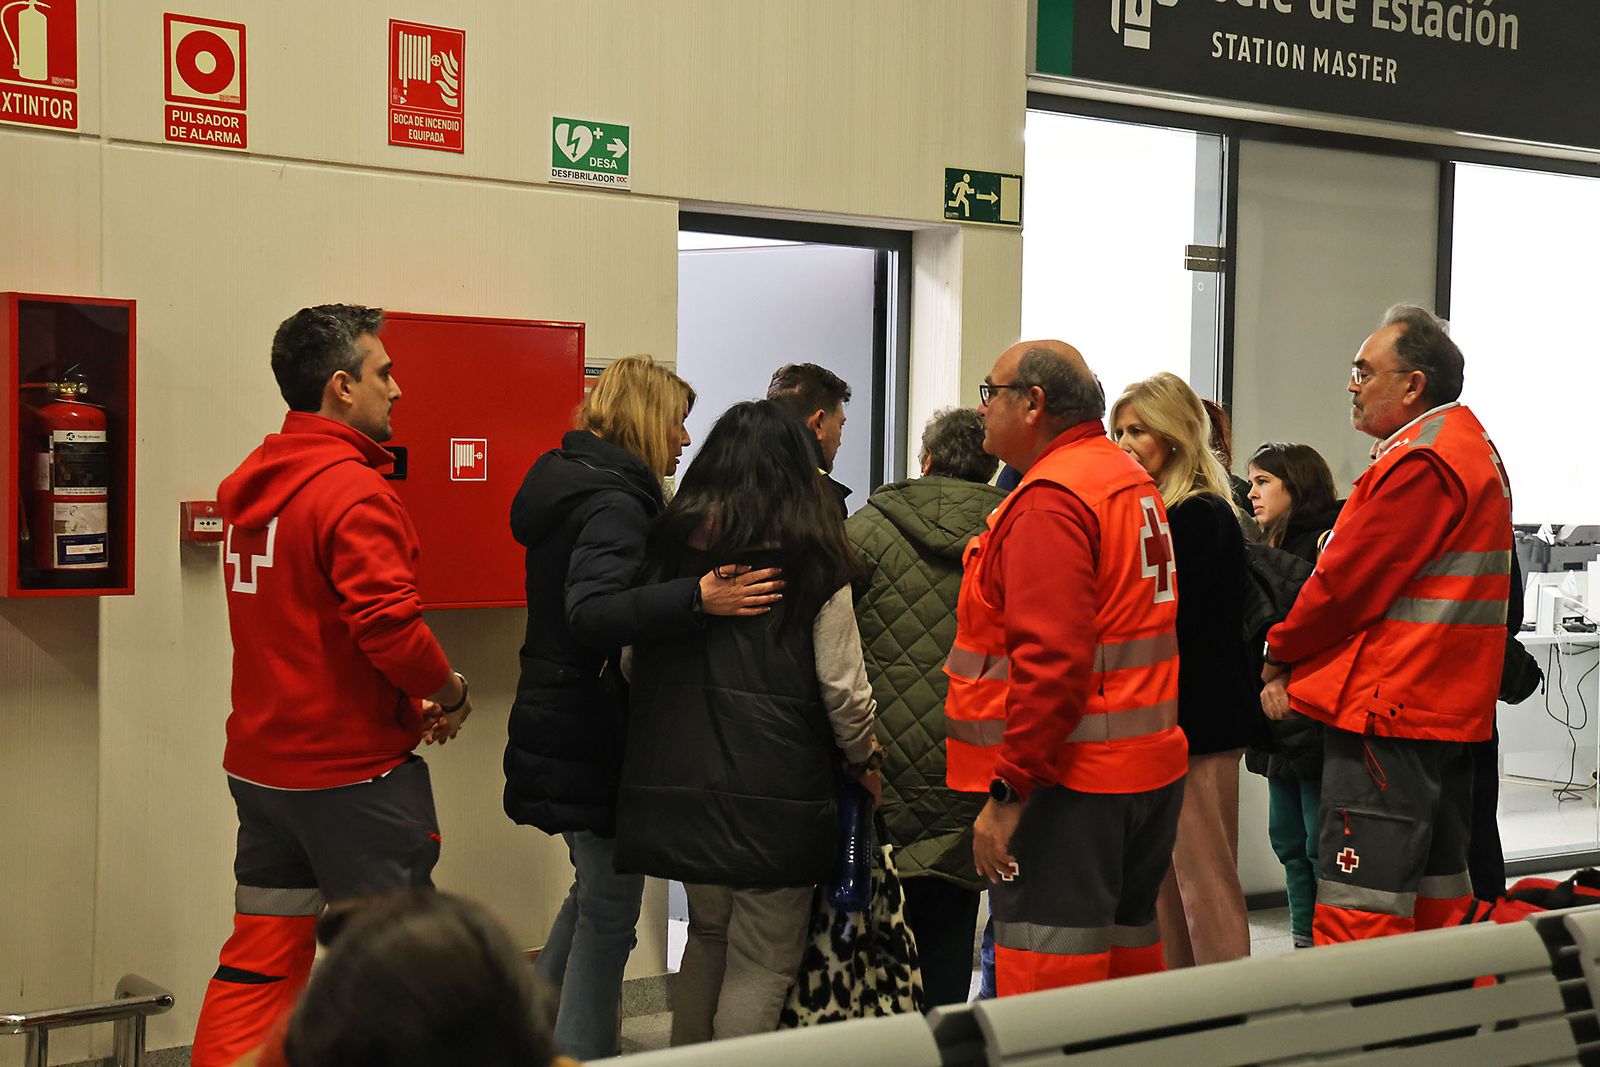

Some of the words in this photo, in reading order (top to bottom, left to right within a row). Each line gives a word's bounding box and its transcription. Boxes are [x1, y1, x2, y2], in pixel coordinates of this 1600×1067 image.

[1372, 0, 1519, 50] Estación
[1211, 31, 1305, 71] STATION
[1313, 46, 1397, 84] MASTER
[0, 91, 74, 121] XTINTOR
[172, 109, 240, 129] PULSADOR
[393, 113, 414, 126] BOCA
[414, 115, 424, 127] DE
[425, 117, 460, 132] INCENDIO
[170, 125, 187, 139] DE
[189, 127, 242, 145] ALARMA
[408, 128, 445, 143] EQUIPADA
[589, 156, 618, 170] DESA
[551, 168, 616, 183] DESFIBRILADOR
